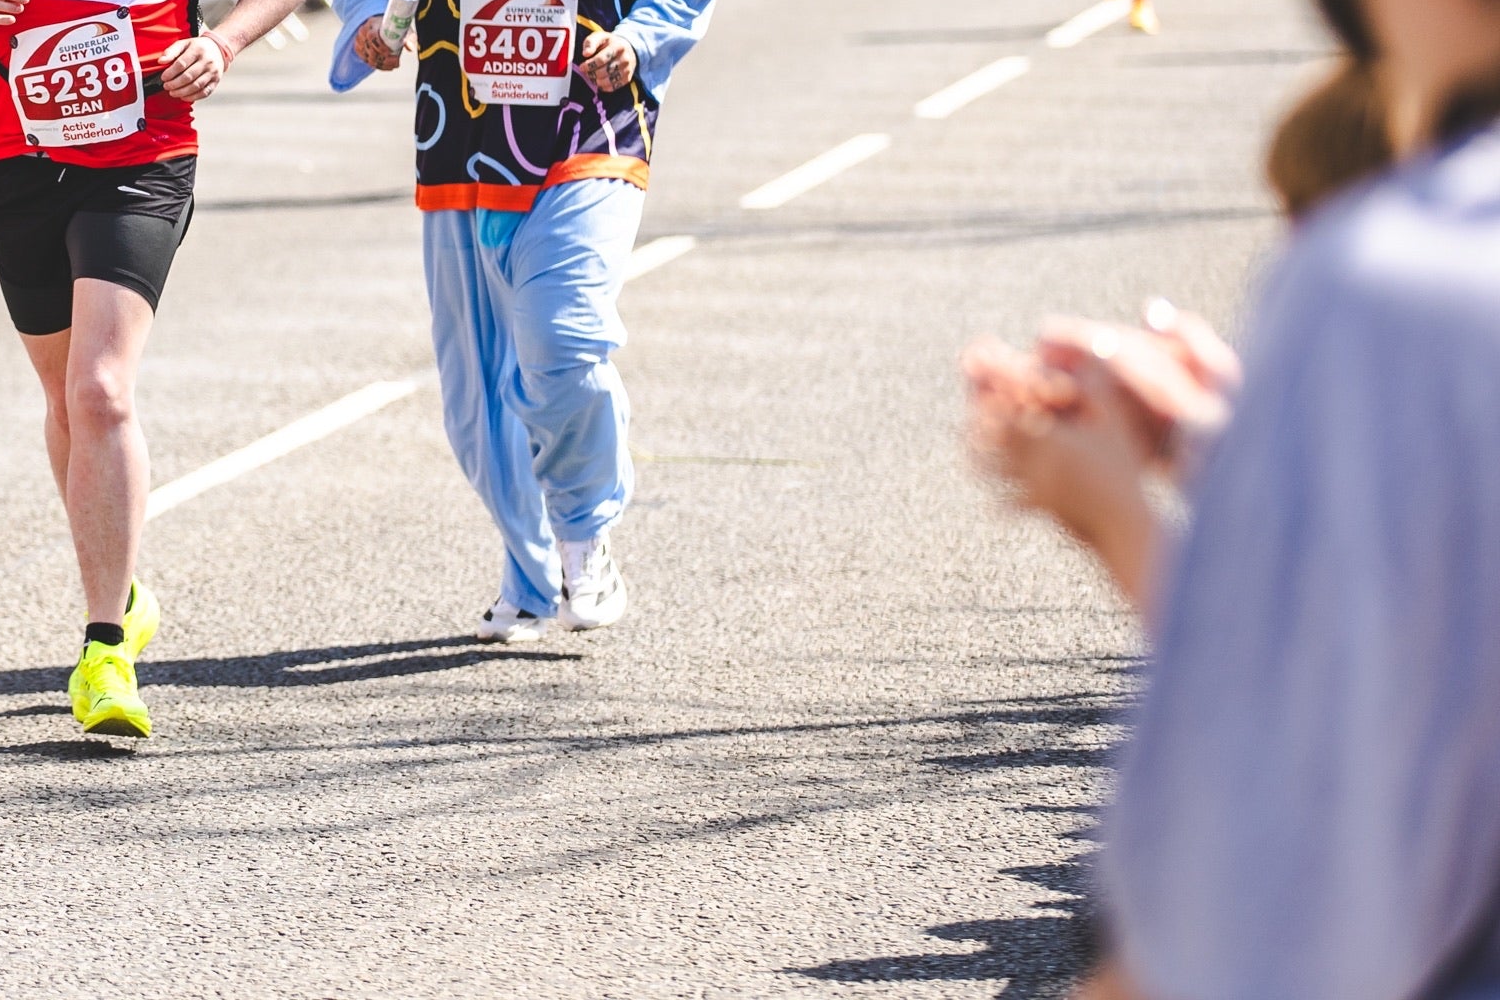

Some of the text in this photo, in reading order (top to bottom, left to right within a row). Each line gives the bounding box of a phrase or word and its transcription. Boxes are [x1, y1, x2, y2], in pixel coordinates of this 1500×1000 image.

[505, 14, 554, 23] CITY 10K
[506, 7, 565, 15] SUNDERLAND
[59, 34, 120, 53] SUNDERLAND
[468, 26, 567, 61] 3407
[59, 44, 110, 63] CITY 10K
[482, 61, 548, 75] ADDISON
[23, 56, 129, 104] 5238
[492, 80, 524, 89] Active
[492, 90, 549, 100] Sunderland
[60, 100, 104, 116] DEAN
[62, 122, 96, 132] Active
[63, 124, 124, 141] Sunderland
